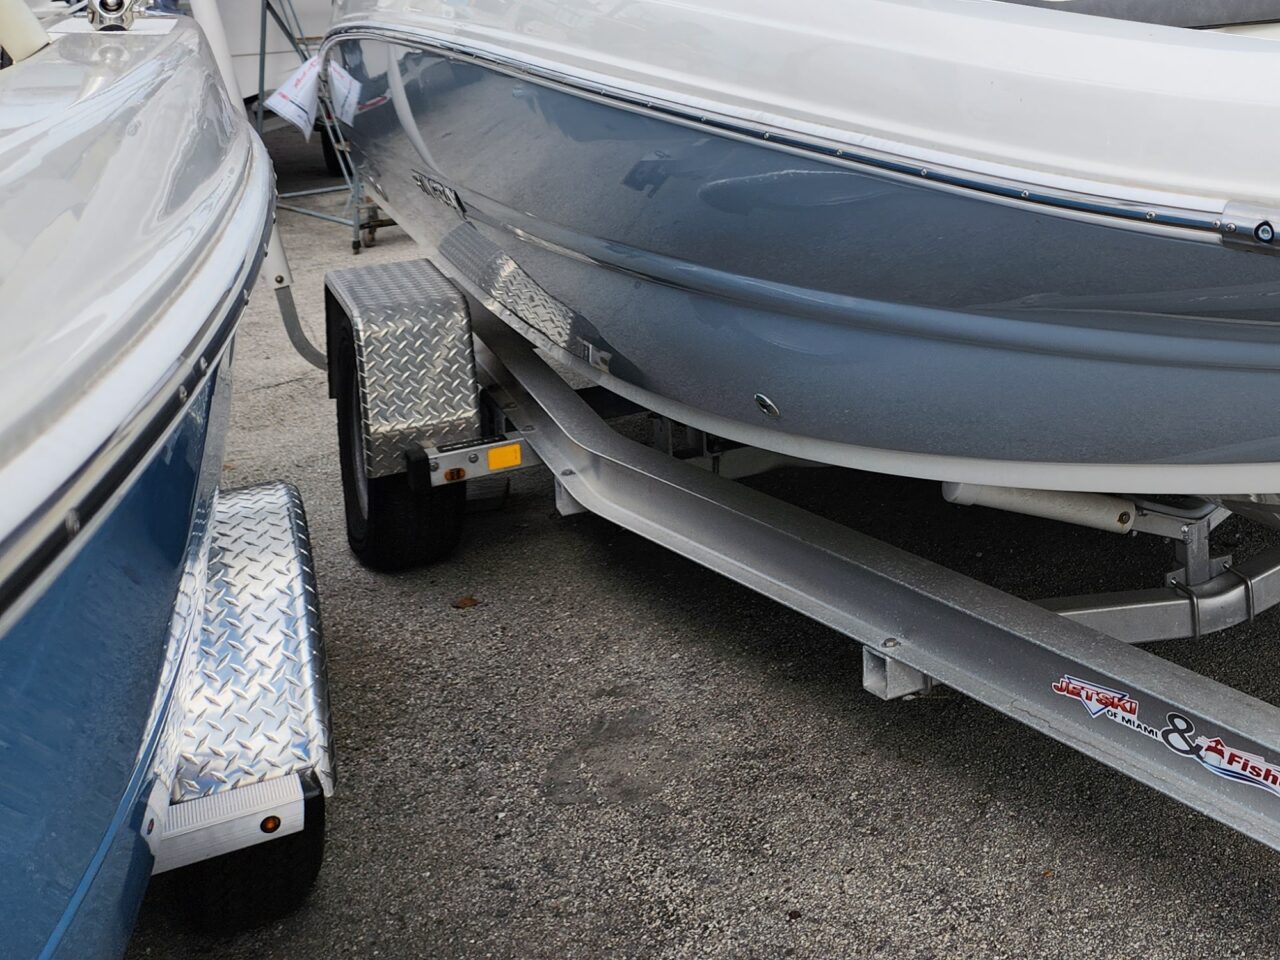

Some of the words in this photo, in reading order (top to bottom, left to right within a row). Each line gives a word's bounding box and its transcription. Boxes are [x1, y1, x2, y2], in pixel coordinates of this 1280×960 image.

[1106, 709, 1119, 720] OF
[1121, 714, 1159, 739] MIAMI
[1161, 712, 1204, 761] &
